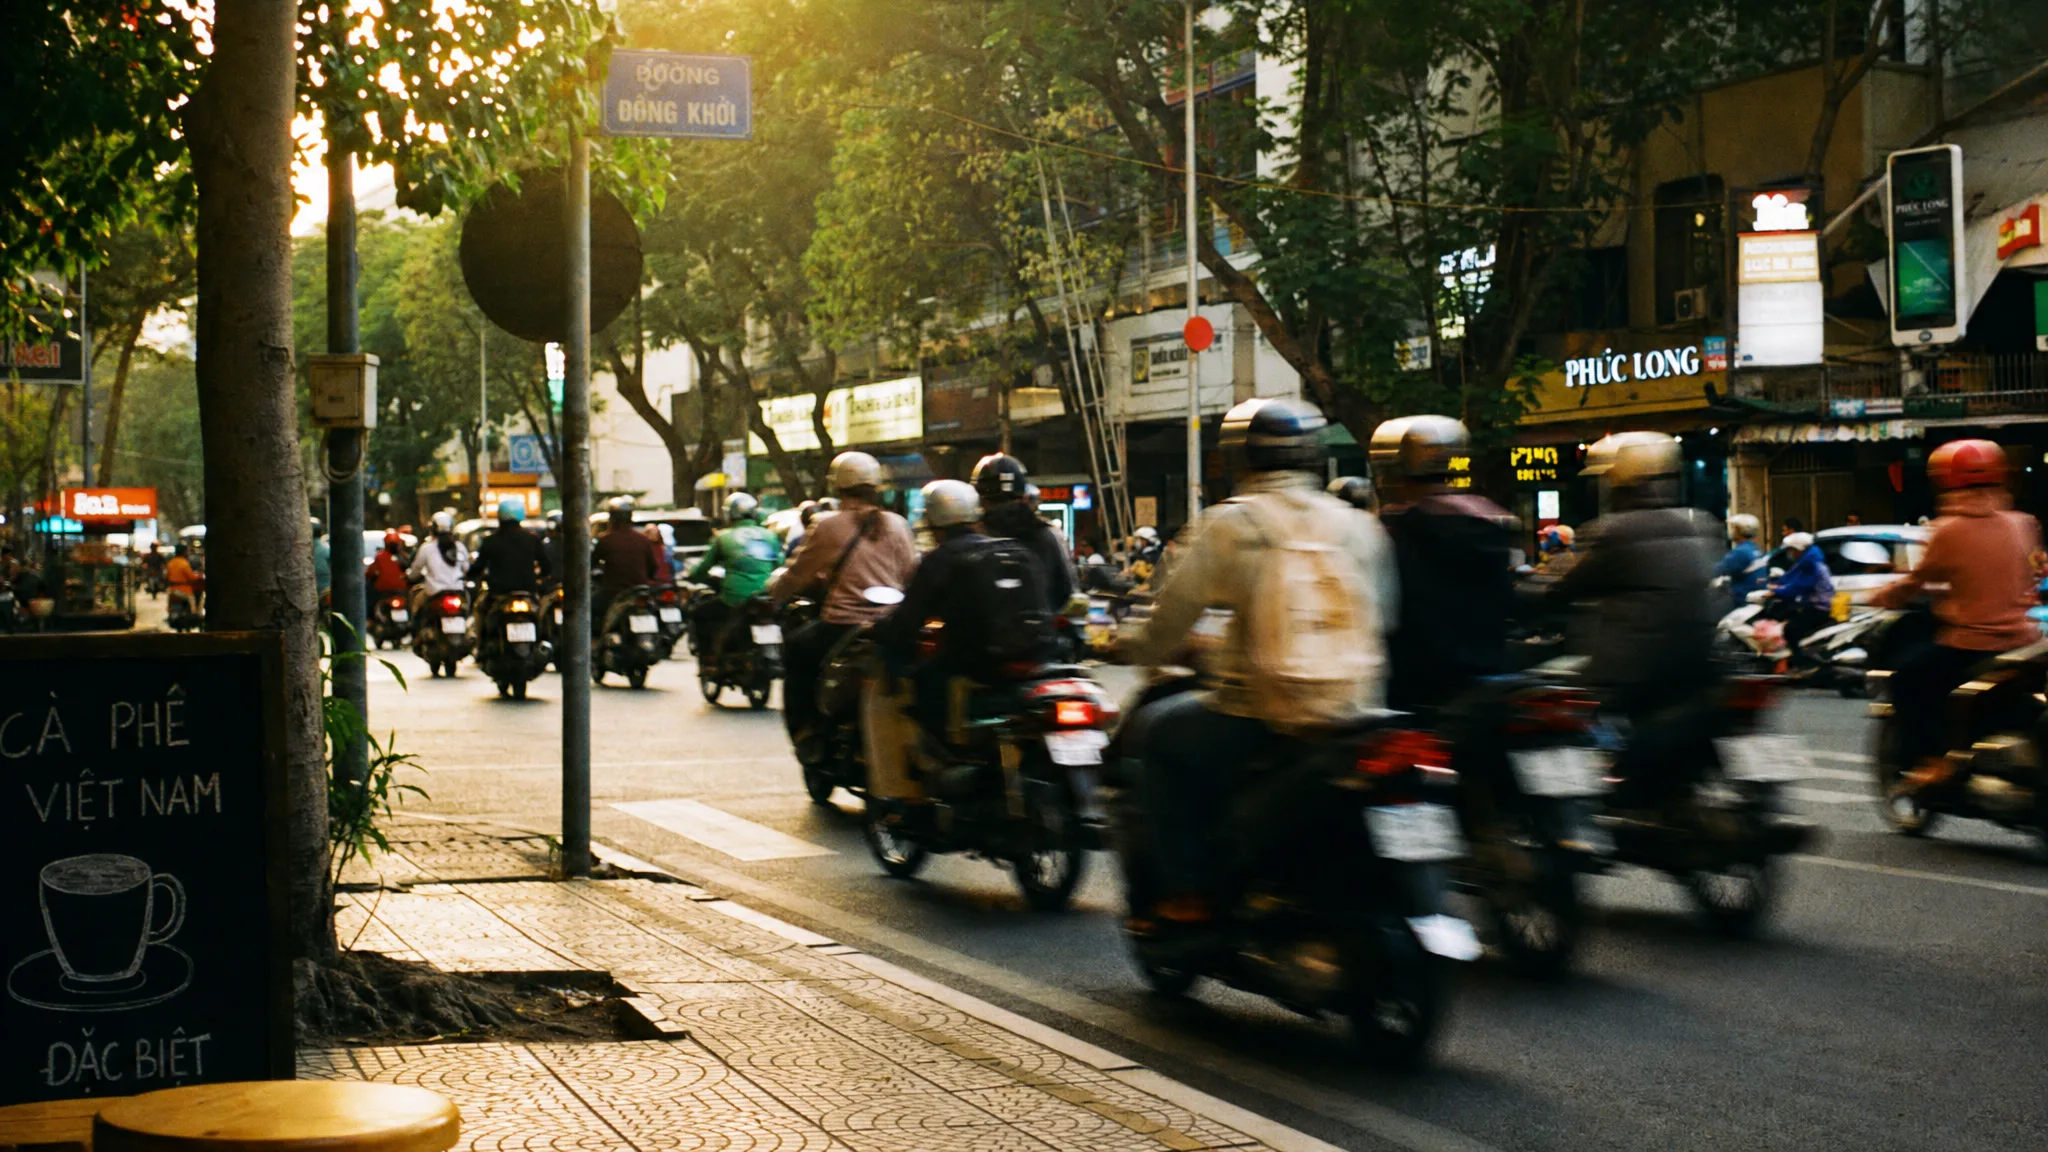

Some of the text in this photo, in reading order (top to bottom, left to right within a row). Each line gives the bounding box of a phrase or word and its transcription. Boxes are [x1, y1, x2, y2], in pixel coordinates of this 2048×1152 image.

[1565, 345, 1700, 388] PHÚC LONG
[0, 683, 190, 758] CÀ PHÊ
[25, 768, 222, 831] VIỆT NAM
[39, 1026, 212, 1094] ĐẶC BIỆT
